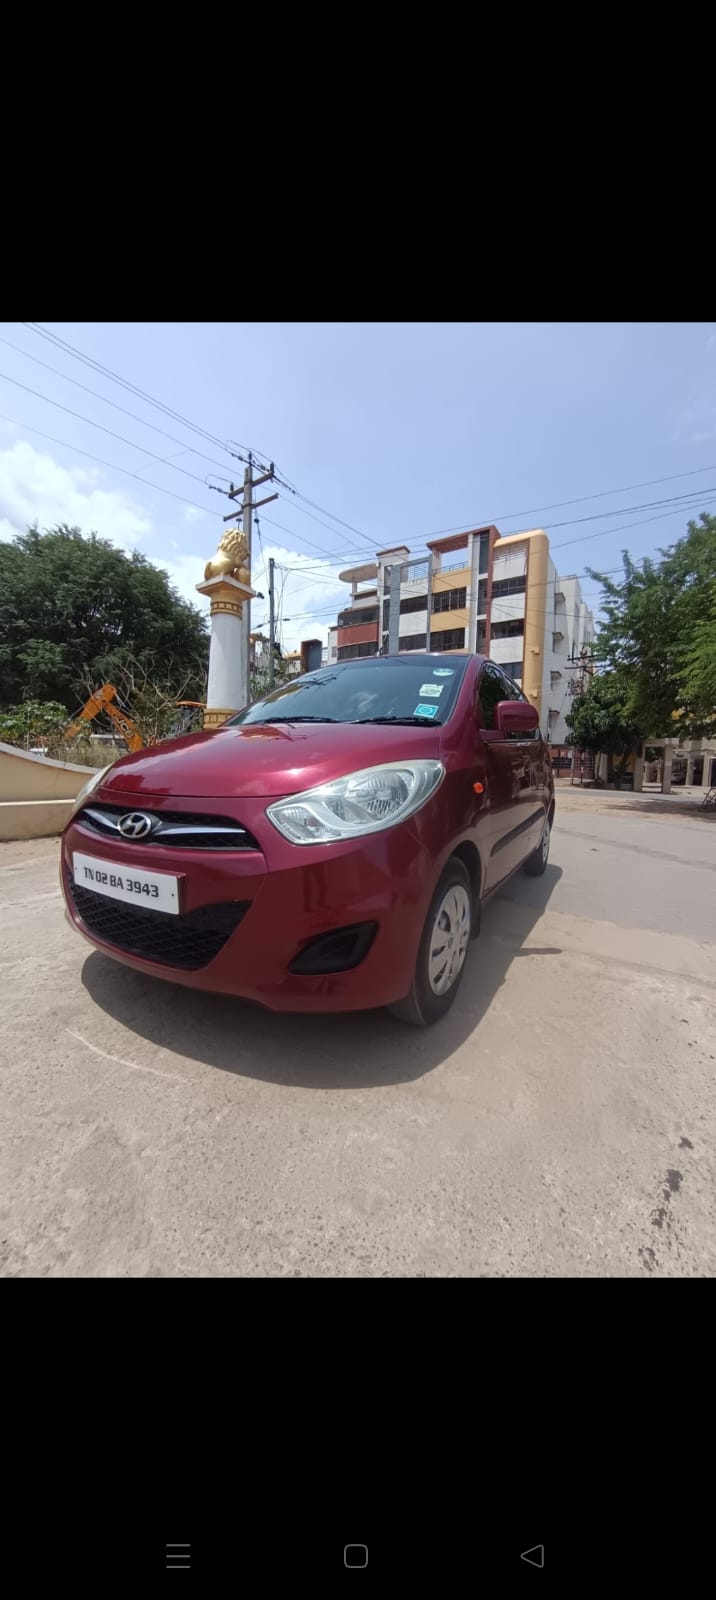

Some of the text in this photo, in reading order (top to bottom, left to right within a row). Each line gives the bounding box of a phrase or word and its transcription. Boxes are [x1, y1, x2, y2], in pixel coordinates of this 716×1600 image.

[84, 867, 159, 898] TN 02 BA 3943
